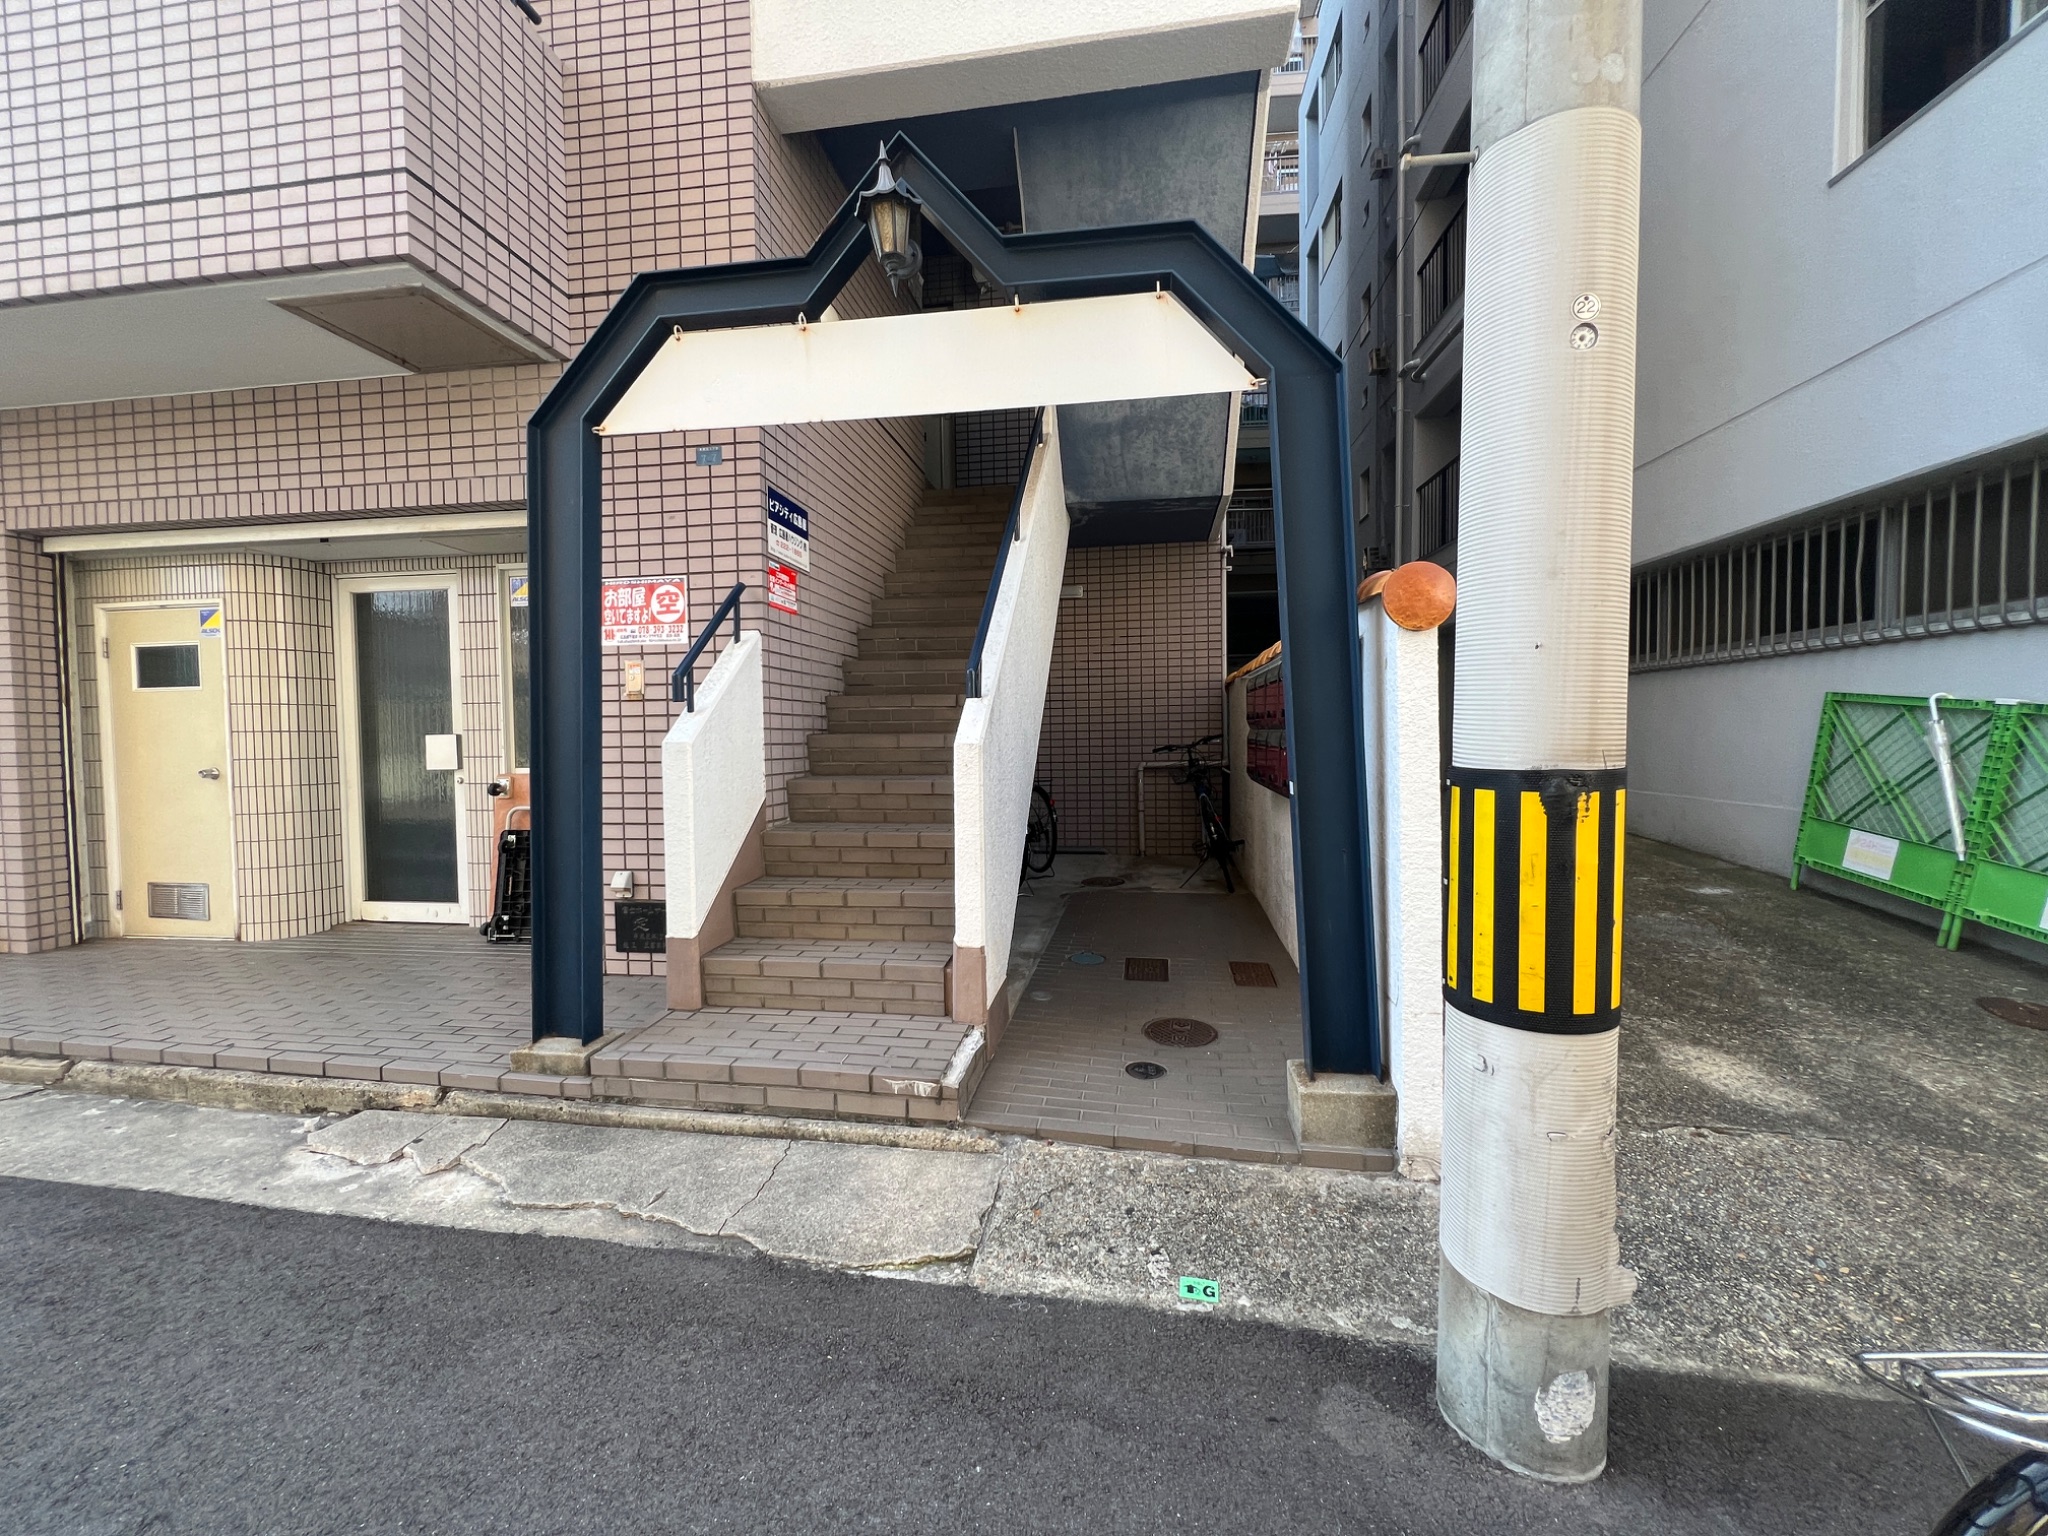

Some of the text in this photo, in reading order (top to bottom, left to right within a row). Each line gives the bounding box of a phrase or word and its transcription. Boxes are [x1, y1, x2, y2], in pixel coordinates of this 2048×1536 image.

[1577, 300, 1595, 313] 22
[605, 587, 646, 607] お部屋
[656, 590, 681, 615] 空
[1203, 1285, 1216, 1298] G
